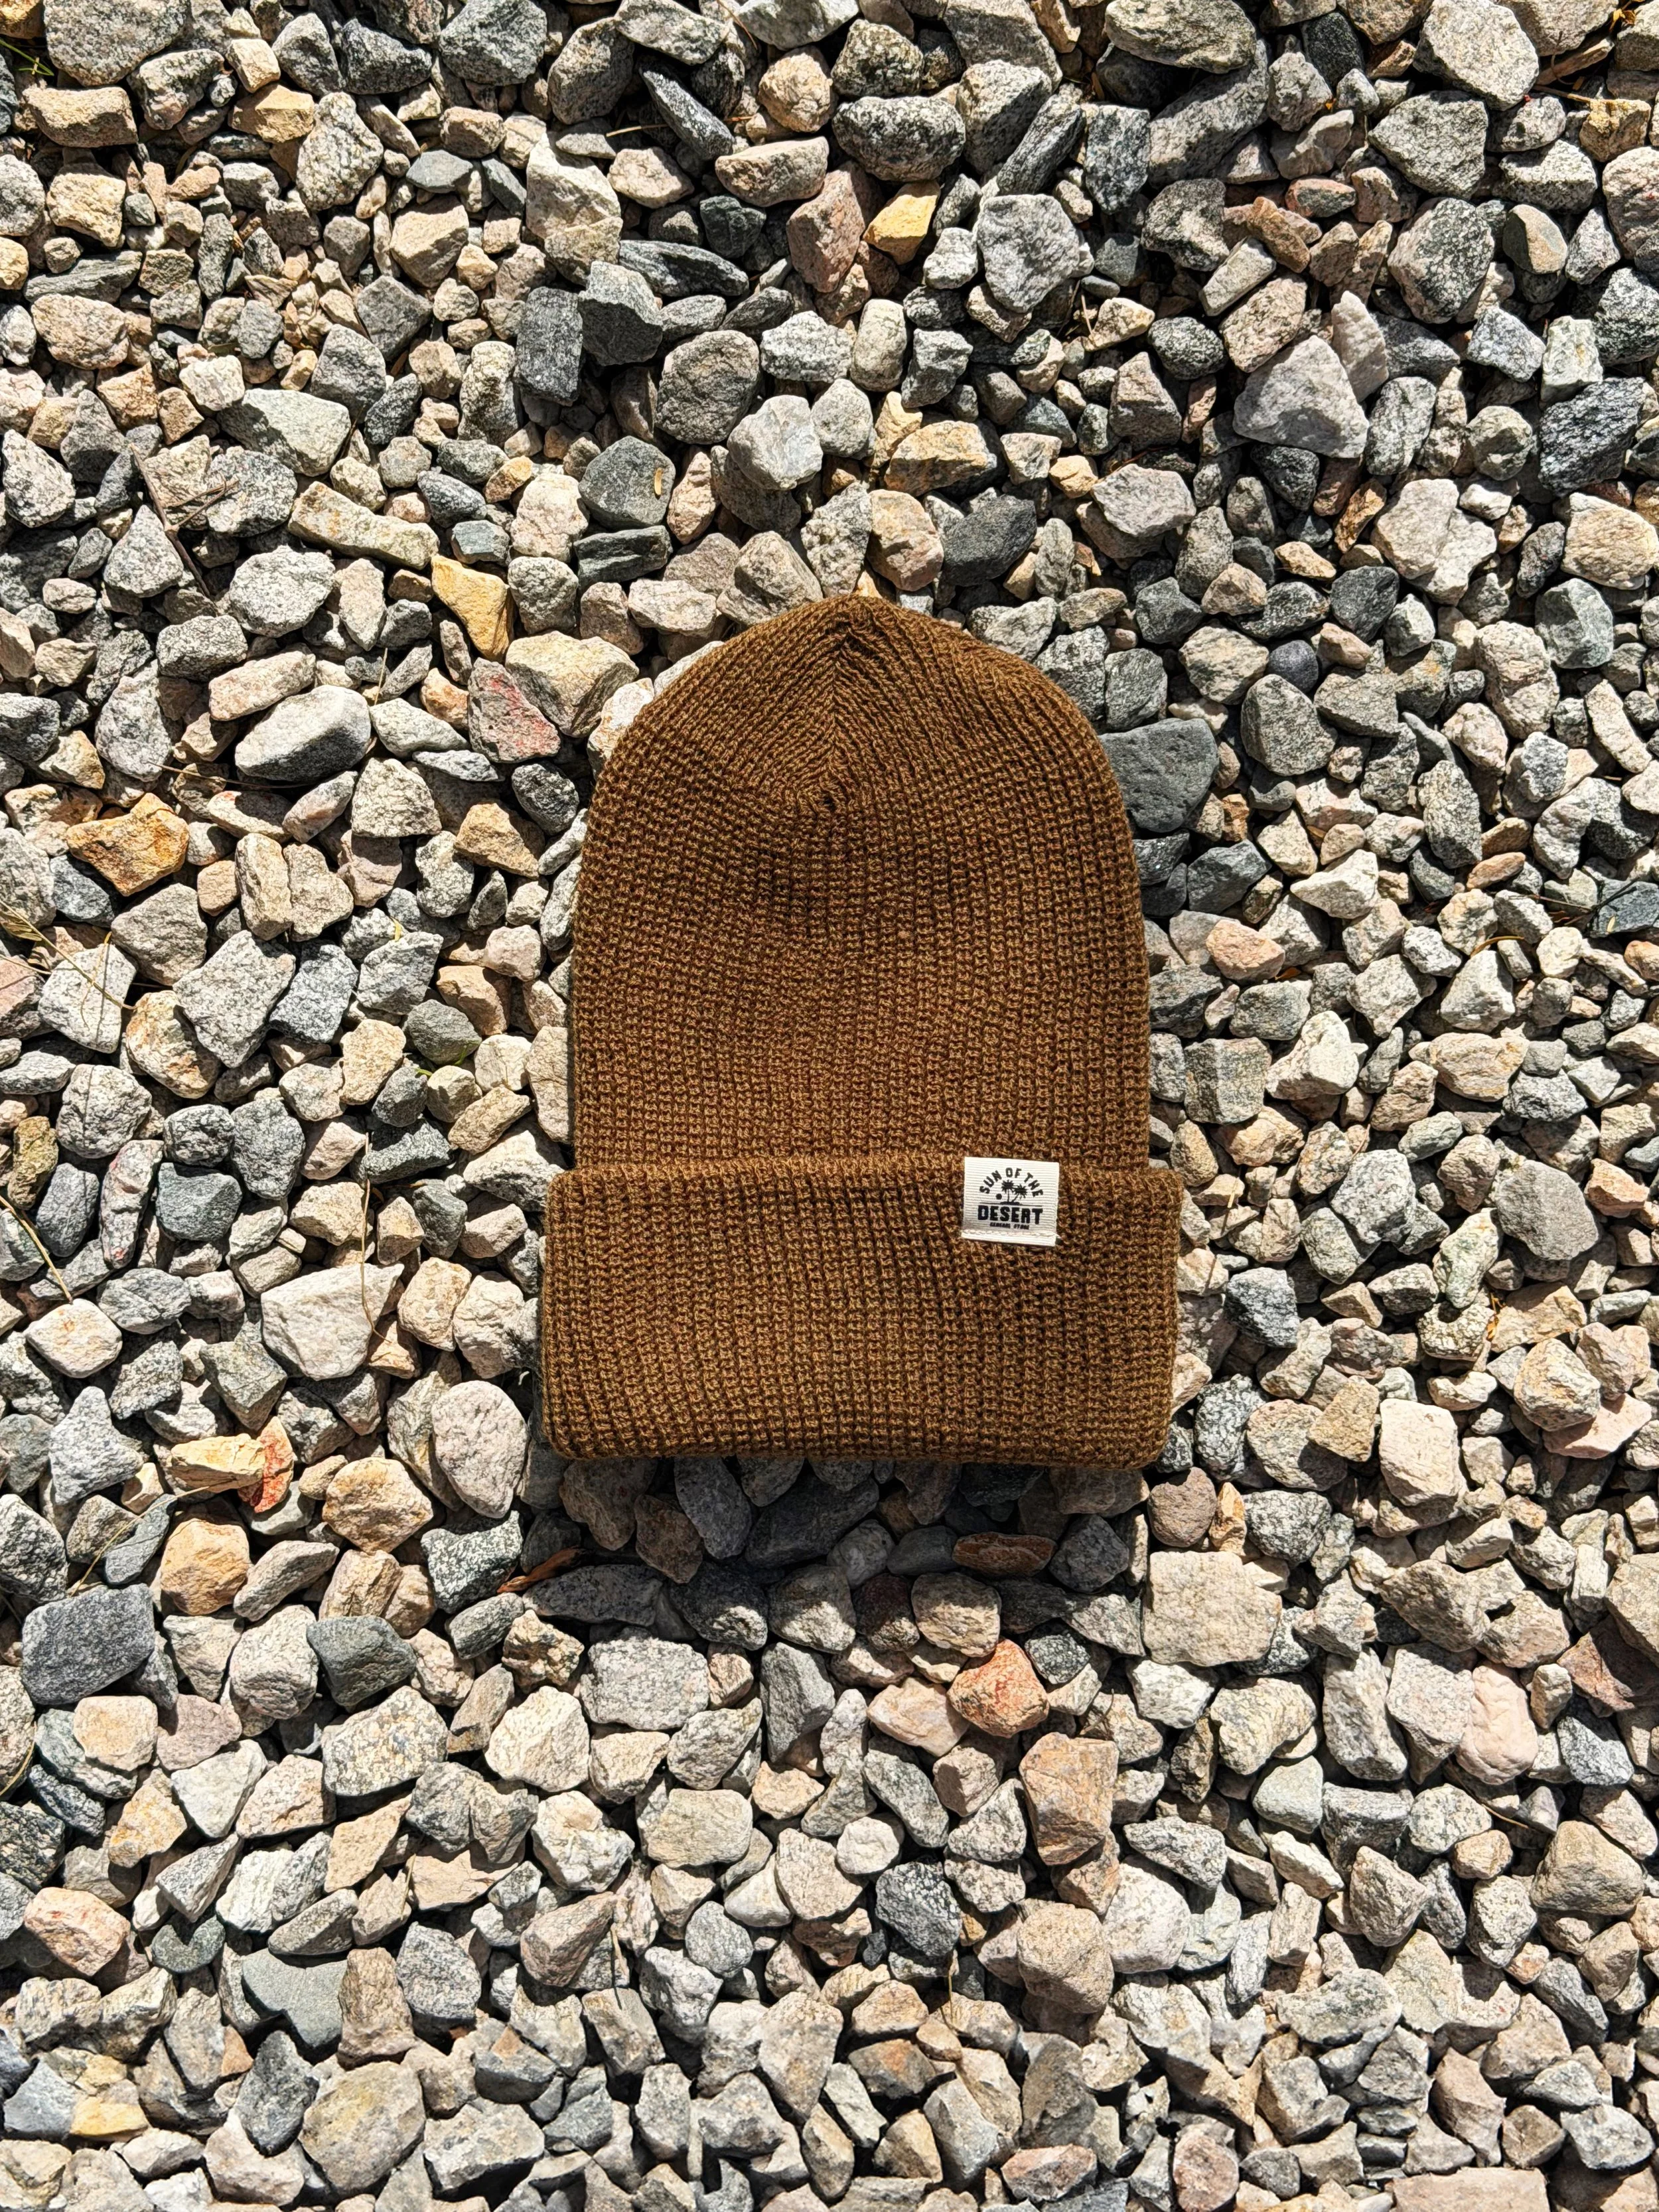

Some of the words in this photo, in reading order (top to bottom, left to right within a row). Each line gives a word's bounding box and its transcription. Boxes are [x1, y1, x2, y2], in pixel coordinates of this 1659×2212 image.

[979, 1170, 1002, 1194] SUN
[1005, 1167, 1022, 1179] OF
[1024, 1173, 1044, 1197] THE
[977, 1205, 1043, 1224] DESERT
